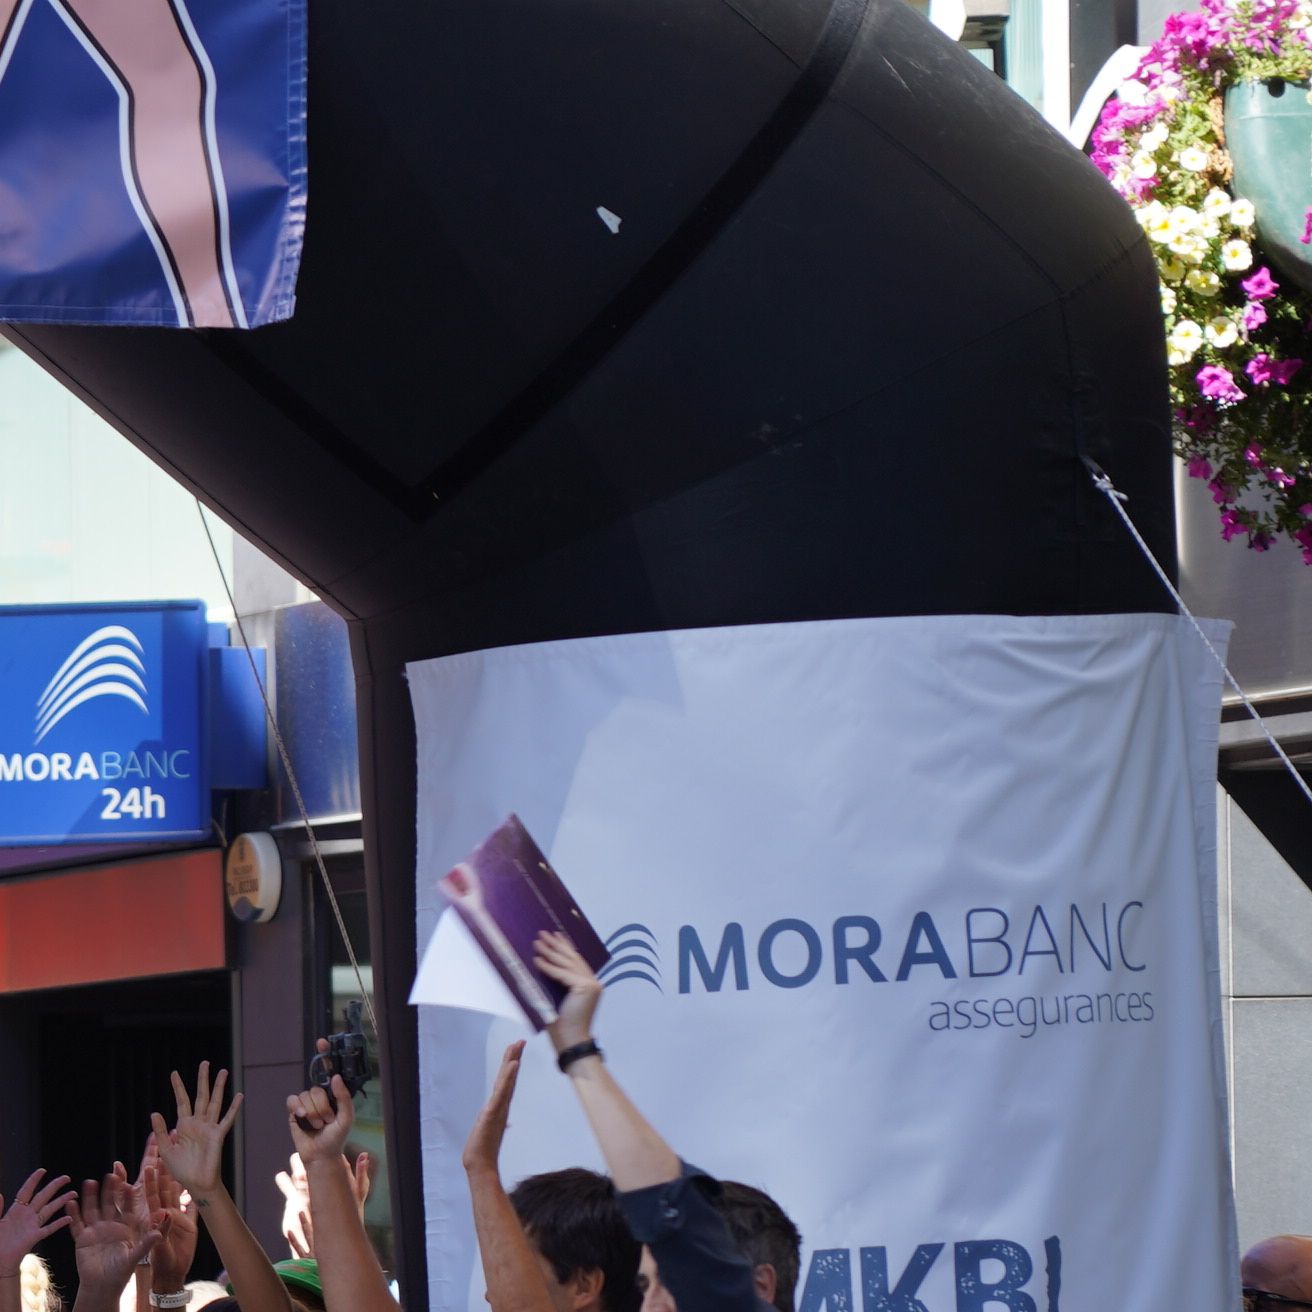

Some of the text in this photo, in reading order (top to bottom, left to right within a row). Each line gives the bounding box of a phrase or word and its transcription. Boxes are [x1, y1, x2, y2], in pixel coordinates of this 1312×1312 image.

[100, 787, 167, 822] 24h
[677, 900, 1147, 995] MORABANC
[928, 989, 1154, 1039] assegurances
